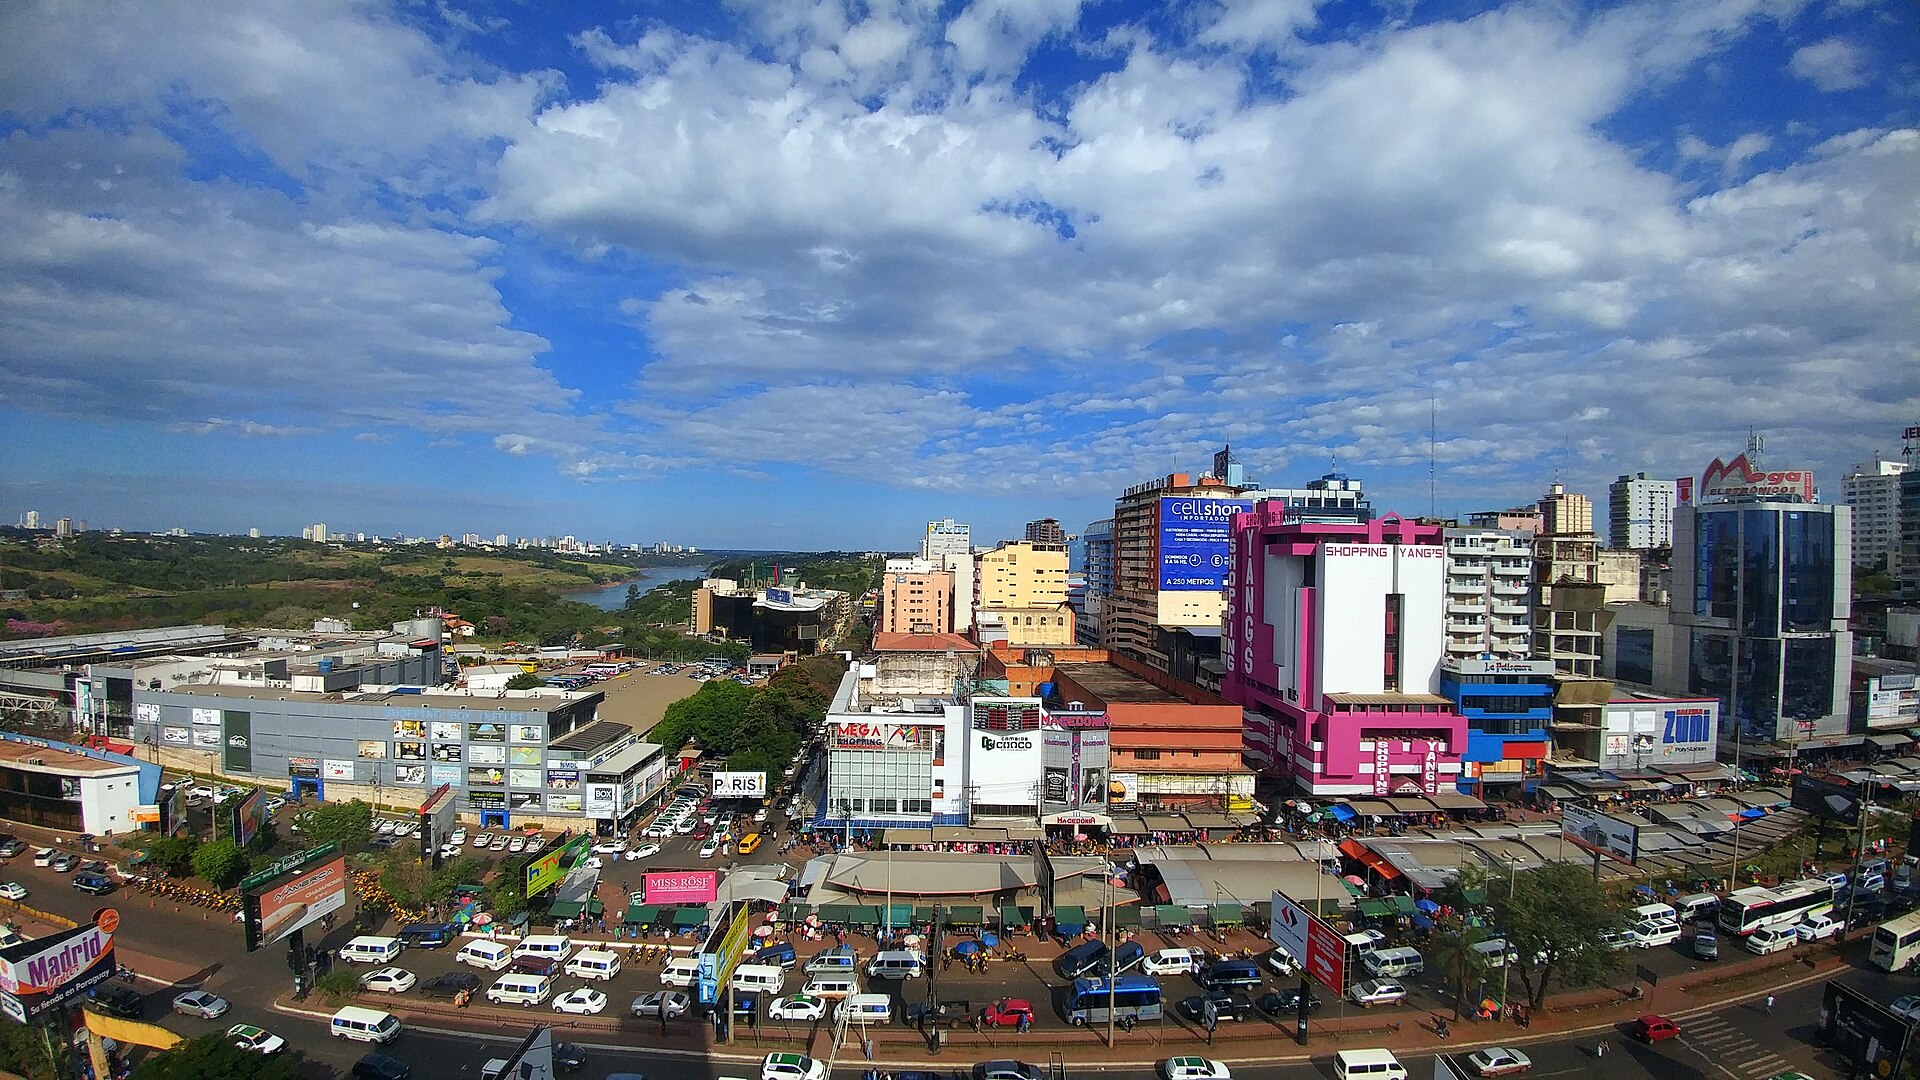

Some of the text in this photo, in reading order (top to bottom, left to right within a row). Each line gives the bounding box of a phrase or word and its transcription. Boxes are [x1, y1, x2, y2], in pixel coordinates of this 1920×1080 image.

[1325, 546, 1443, 559] SHOPPING YANG'S
[1226, 538, 1237, 672] SHOPPING
[383, 708, 524, 721] SHOPPING BOX OUTLET
[1041, 713, 1111, 727] MACEDONIA
[837, 723, 881, 737] MEGA
[836, 738, 883, 746] SHOPPING
[1376, 741, 1389, 794] SHOPPING
[595, 790, 612, 798] BOX
[1056, 816, 1096, 825] MACEDONIA
[651, 875, 710, 887] MISS RÔSE
[27, 931, 103, 989] Madrid
[30, 1005, 41, 1016] Su
[40, 993, 65, 1010] tienda
[65, 987, 76, 998] en
[75, 968, 111, 992] Paraguay
